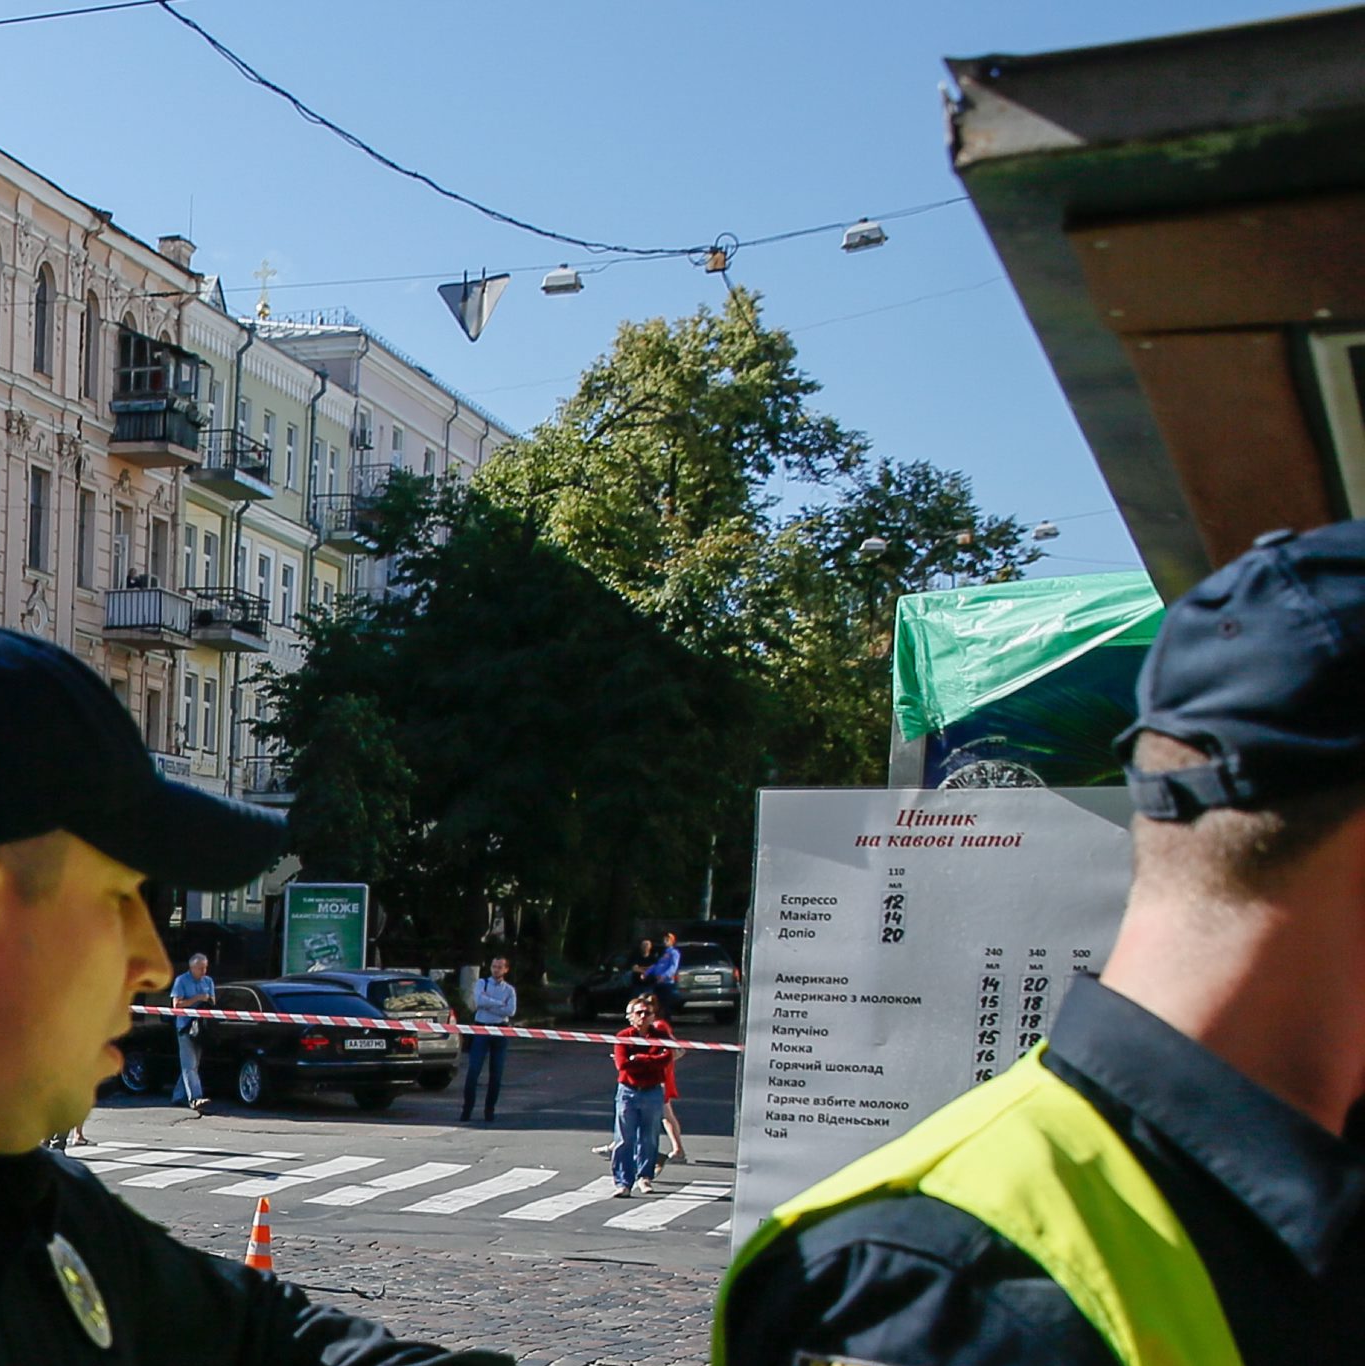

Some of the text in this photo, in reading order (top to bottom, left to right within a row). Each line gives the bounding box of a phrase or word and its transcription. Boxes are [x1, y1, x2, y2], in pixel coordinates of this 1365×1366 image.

[895, 809, 978, 829] Цінник
[855, 832, 1025, 848] на кавові напої
[888, 867, 905, 876] 110
[780, 894, 838, 907] Еспрессо
[883, 893, 905, 910] 12
[318, 903, 360, 913] МОЖЕ
[779, 909, 832, 921] Макіато
[883, 911, 903, 925] 14
[778, 927, 816, 940] Допіо
[881, 927, 905, 943] 20
[985, 948, 1091, 958] 240 340 500
[775, 973, 849, 986] Американо
[982, 976, 1049, 993] 14 20
[774, 990, 922, 1005] Американо з молоком
[980, 995, 1043, 1011] 15 18
[773, 1007, 808, 1019] Латте
[979, 1013, 1042, 1029] 15 18
[772, 1024, 829, 1038] Капучіно
[978, 1030, 1001, 1045] 15
[771, 1041, 813, 1054] Мокка
[976, 1049, 996, 1063] 16
[769, 1059, 884, 1076] Горячий шоколад
[768, 1076, 806, 1088] Какао
[767, 1093, 909, 1111] Гаряче взбите молоко
[766, 1110, 890, 1127] Кава по Віденьськи
[764, 1127, 788, 1139] Чай
